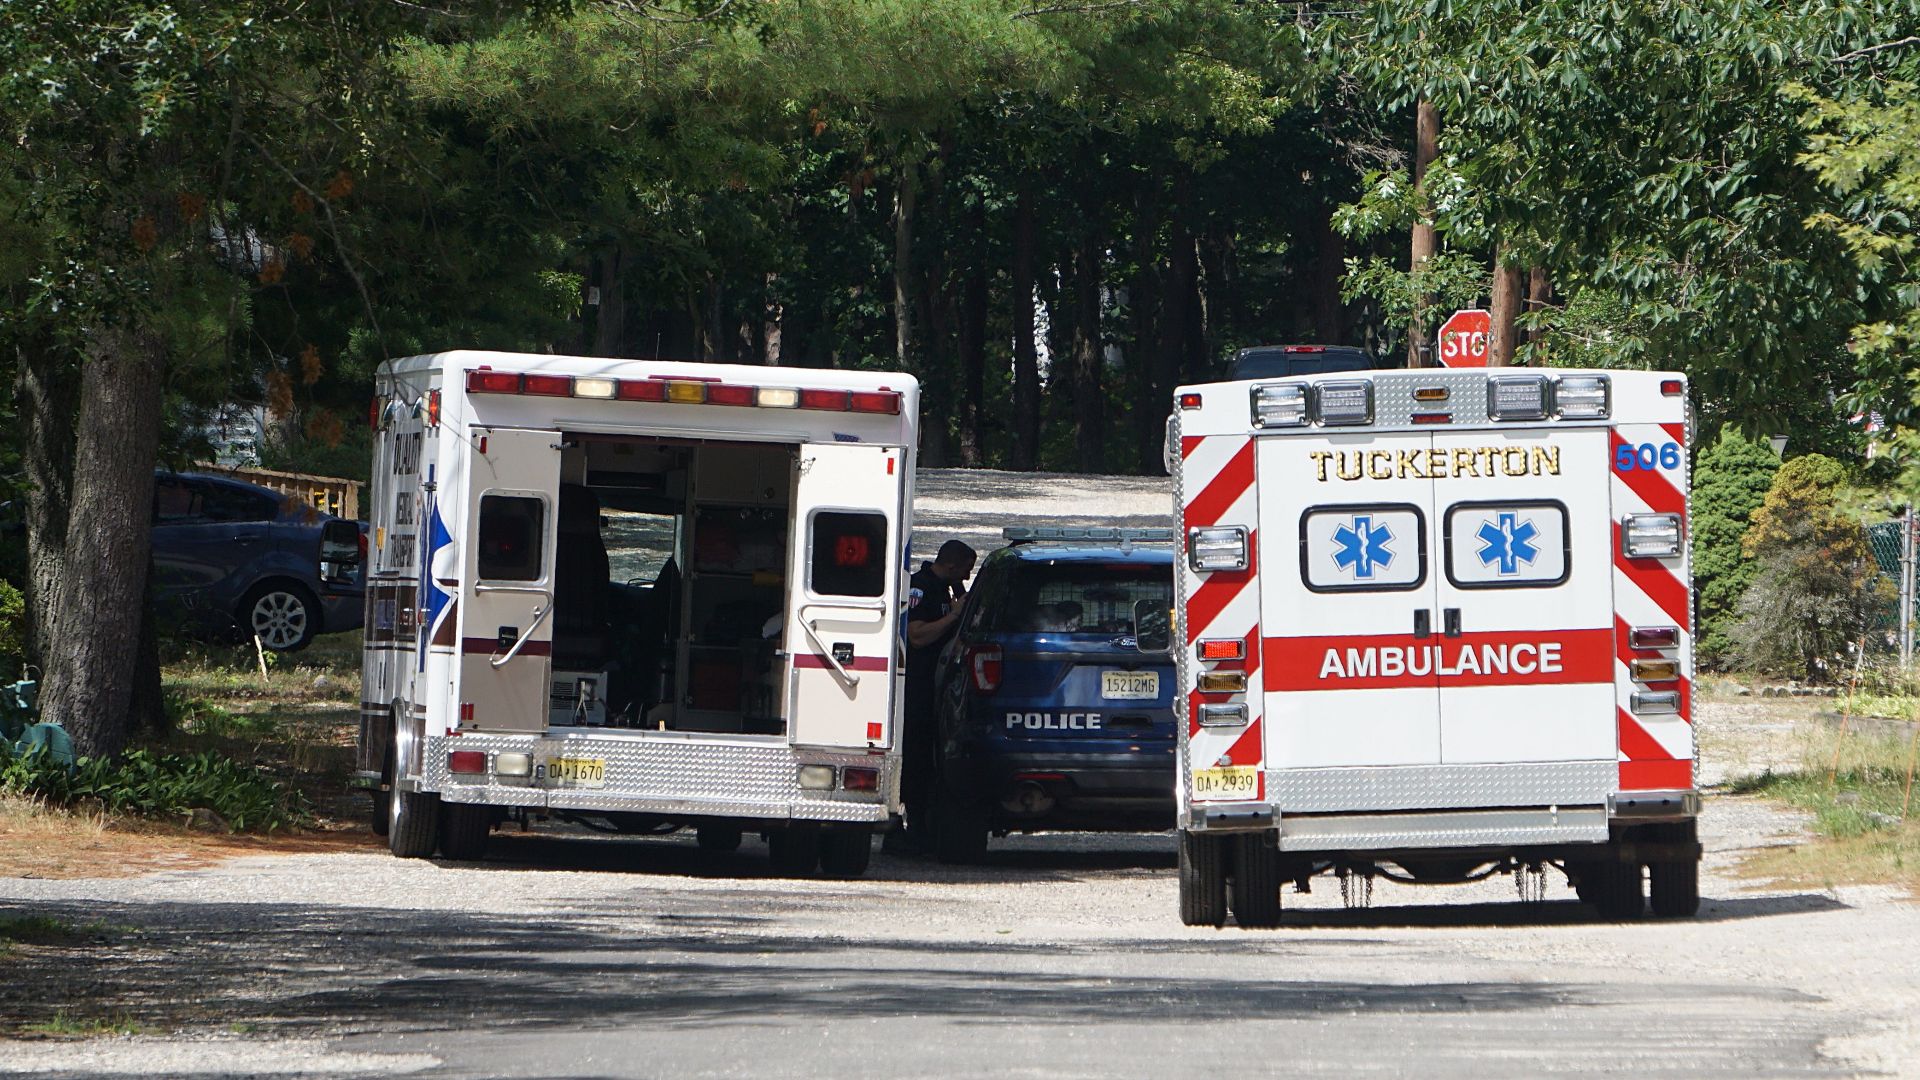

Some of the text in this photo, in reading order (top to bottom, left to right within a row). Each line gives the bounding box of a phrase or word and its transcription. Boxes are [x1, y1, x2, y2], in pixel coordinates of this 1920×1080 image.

[1444, 331, 1489, 357] STO
[1310, 445, 1561, 482] TUCKERTON
[1615, 442, 1680, 471] 506
[1319, 642, 1563, 679] AMBULANCE
[1106, 678, 1155, 692] 15212MG
[1006, 712, 1102, 730] POLICE
